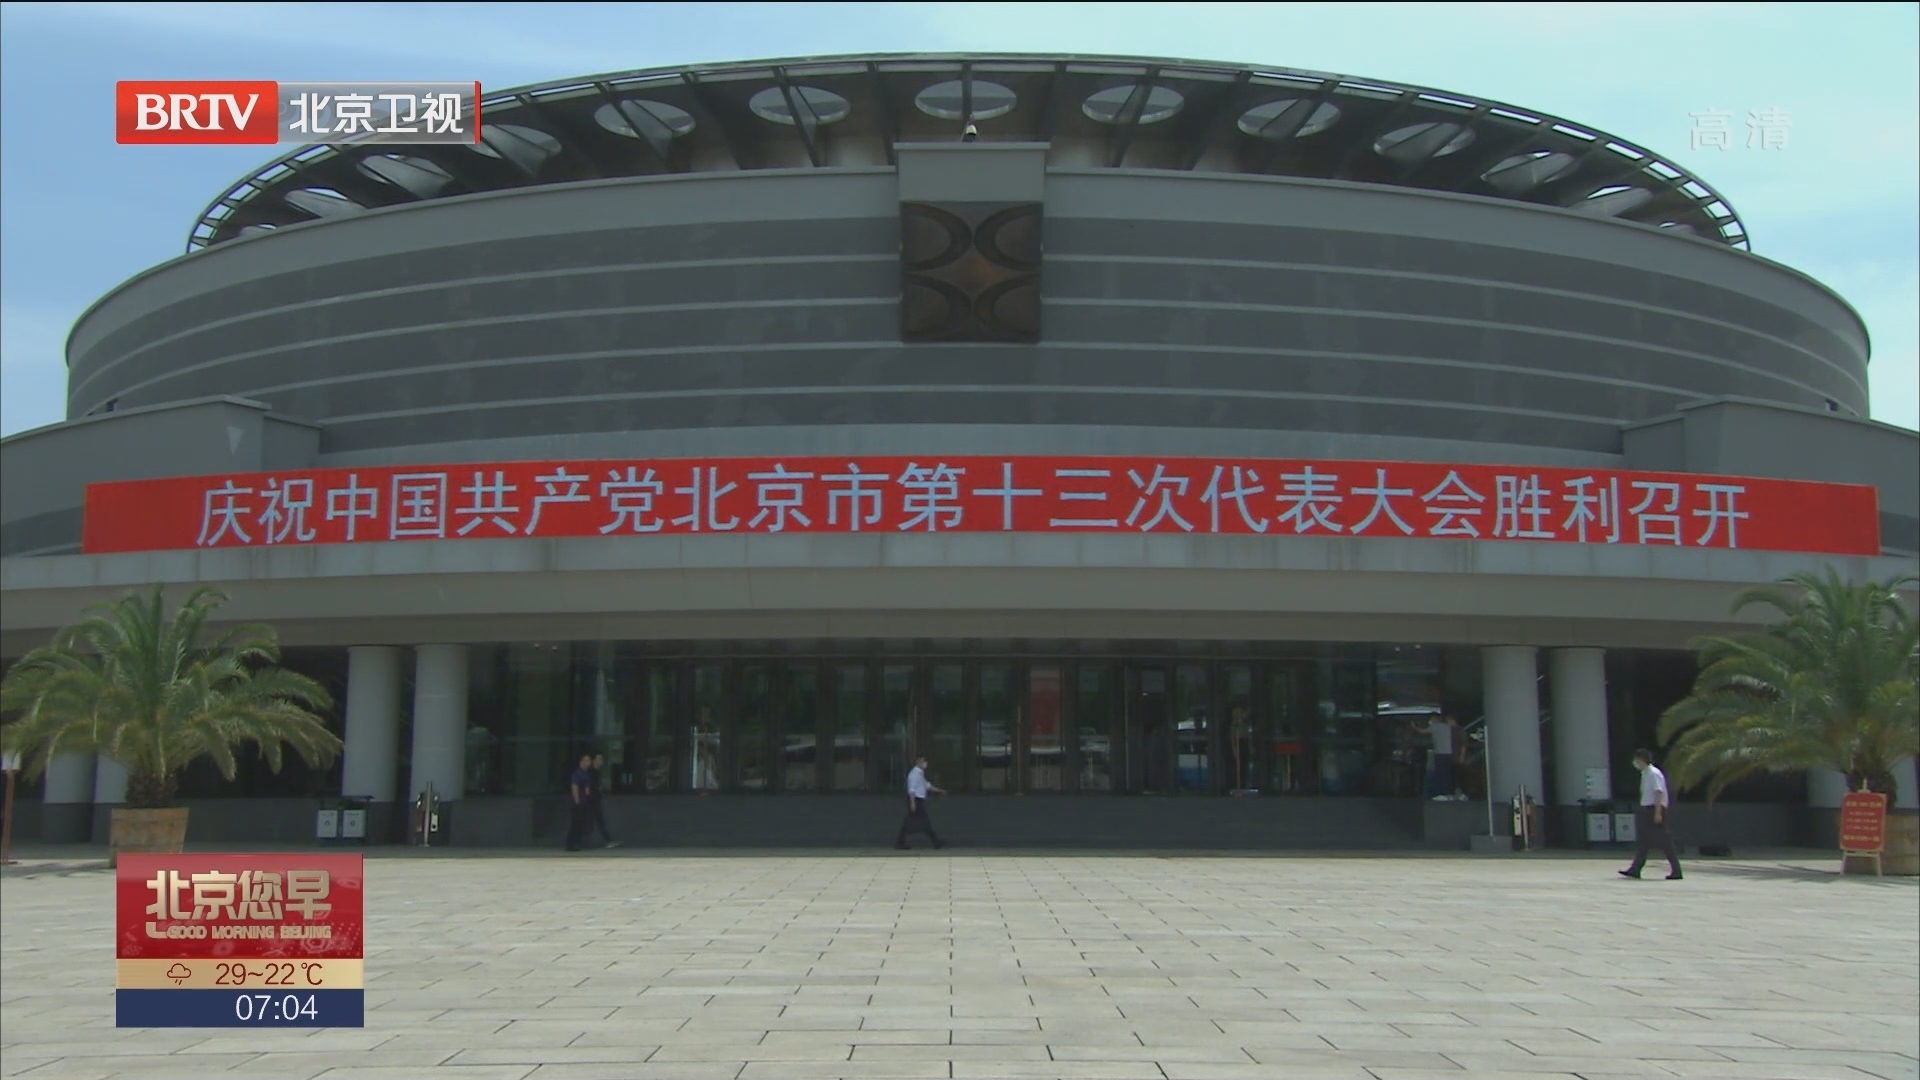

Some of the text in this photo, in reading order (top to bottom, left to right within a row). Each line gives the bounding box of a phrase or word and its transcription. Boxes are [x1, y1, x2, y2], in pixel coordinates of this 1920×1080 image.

[196, 462, 1749, 549] 庆祝中国共产党北京市第十三次代表大会胜利召开
